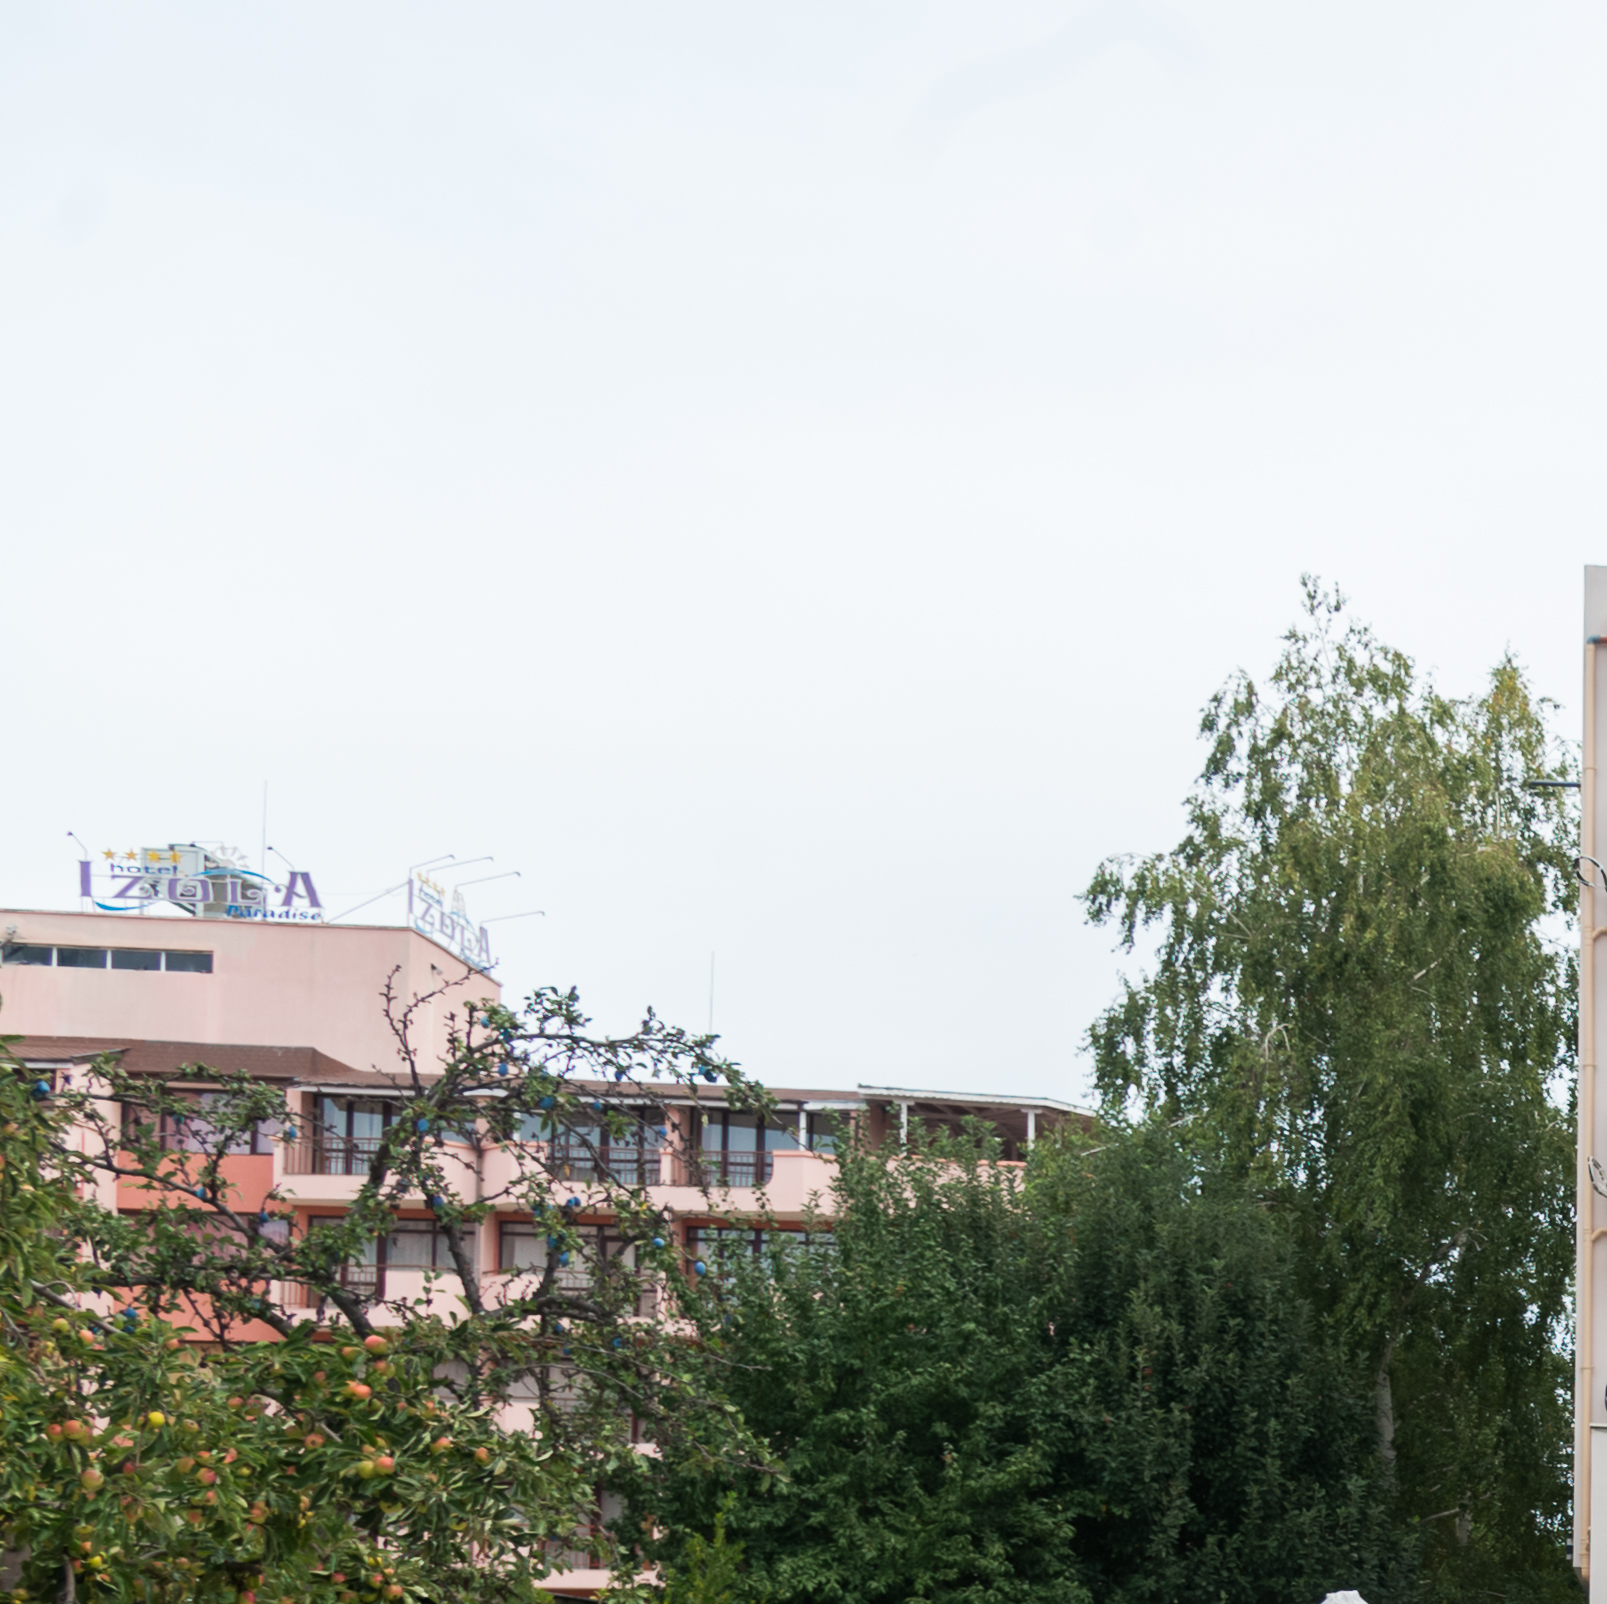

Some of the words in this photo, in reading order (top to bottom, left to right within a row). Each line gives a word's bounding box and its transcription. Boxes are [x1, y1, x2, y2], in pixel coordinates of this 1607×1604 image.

[110, 863, 178, 875] hotel
[79, 860, 322, 908] IZOLA
[226, 905, 322, 921] Paradise
